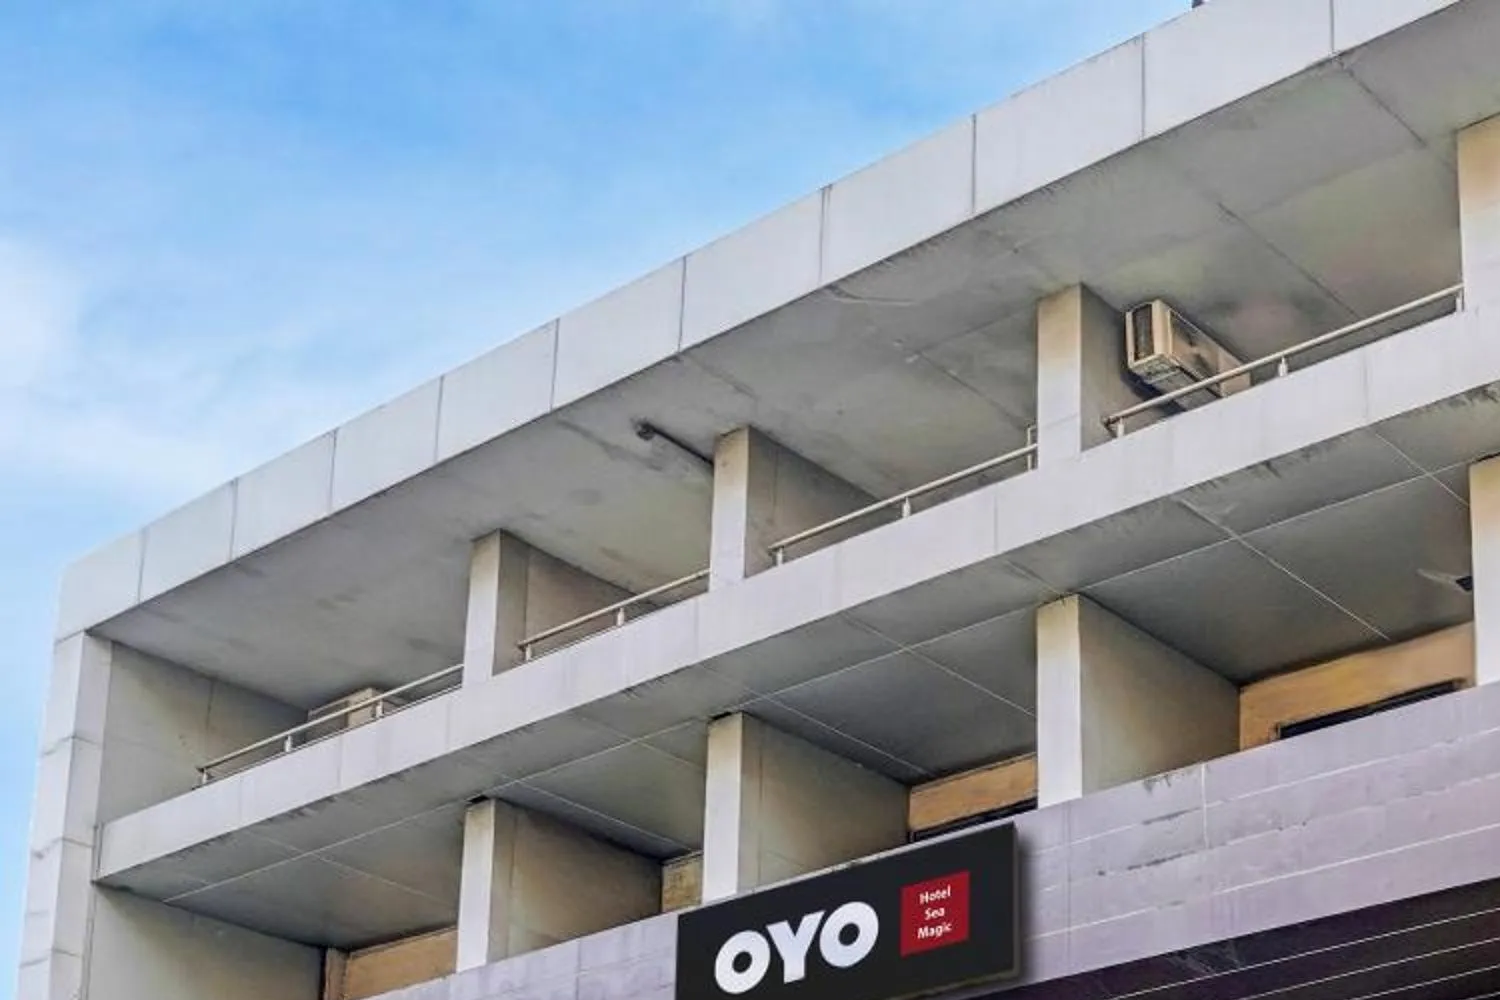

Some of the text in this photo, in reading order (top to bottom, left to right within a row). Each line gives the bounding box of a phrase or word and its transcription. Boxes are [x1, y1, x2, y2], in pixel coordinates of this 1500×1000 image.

[919, 885, 951, 905] Hotel
[924, 907, 945, 921] Sea
[917, 922, 952, 941] Magic
[714, 901, 879, 994] OYO
